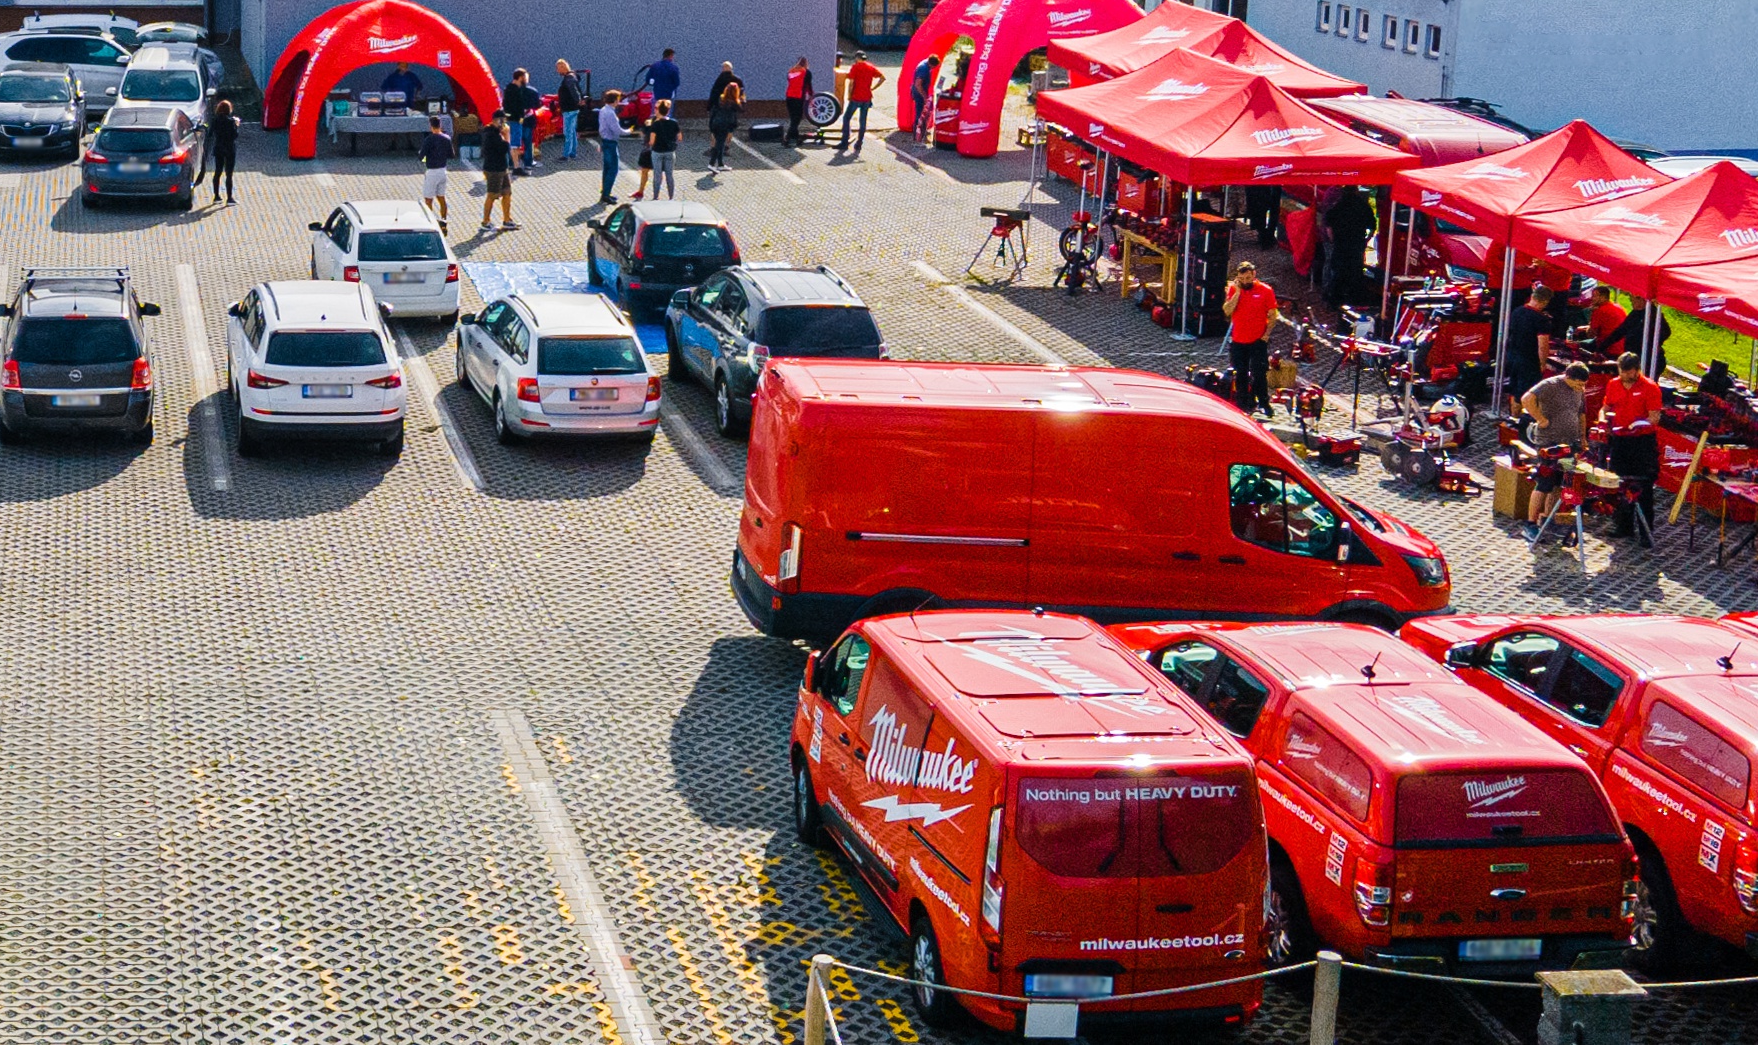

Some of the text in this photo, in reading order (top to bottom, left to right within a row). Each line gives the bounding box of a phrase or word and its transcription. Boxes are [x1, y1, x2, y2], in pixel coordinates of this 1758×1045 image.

[985, 7, 1009, 43] HEAVY
[979, 41, 993, 60] but
[969, 59, 989, 107] Nothing
[1250, 125, 1324, 145] Milwaukee
[1572, 175, 1655, 198] Milwaukee
[865, 704, 974, 794] Milwaukee
[1026, 788, 1091, 803] Nothing
[1095, 789, 1122, 801] but
[1125, 786, 1186, 801] HEAVY
[1462, 774, 1527, 802] Milwaukee
[1611, 762, 1698, 823] milwaukeetool.cz
[1706, 820, 1724, 836] M12
[1398, 908, 1612, 923] RANGER
[1080, 933, 1245, 951] milwaukeetool.cz
